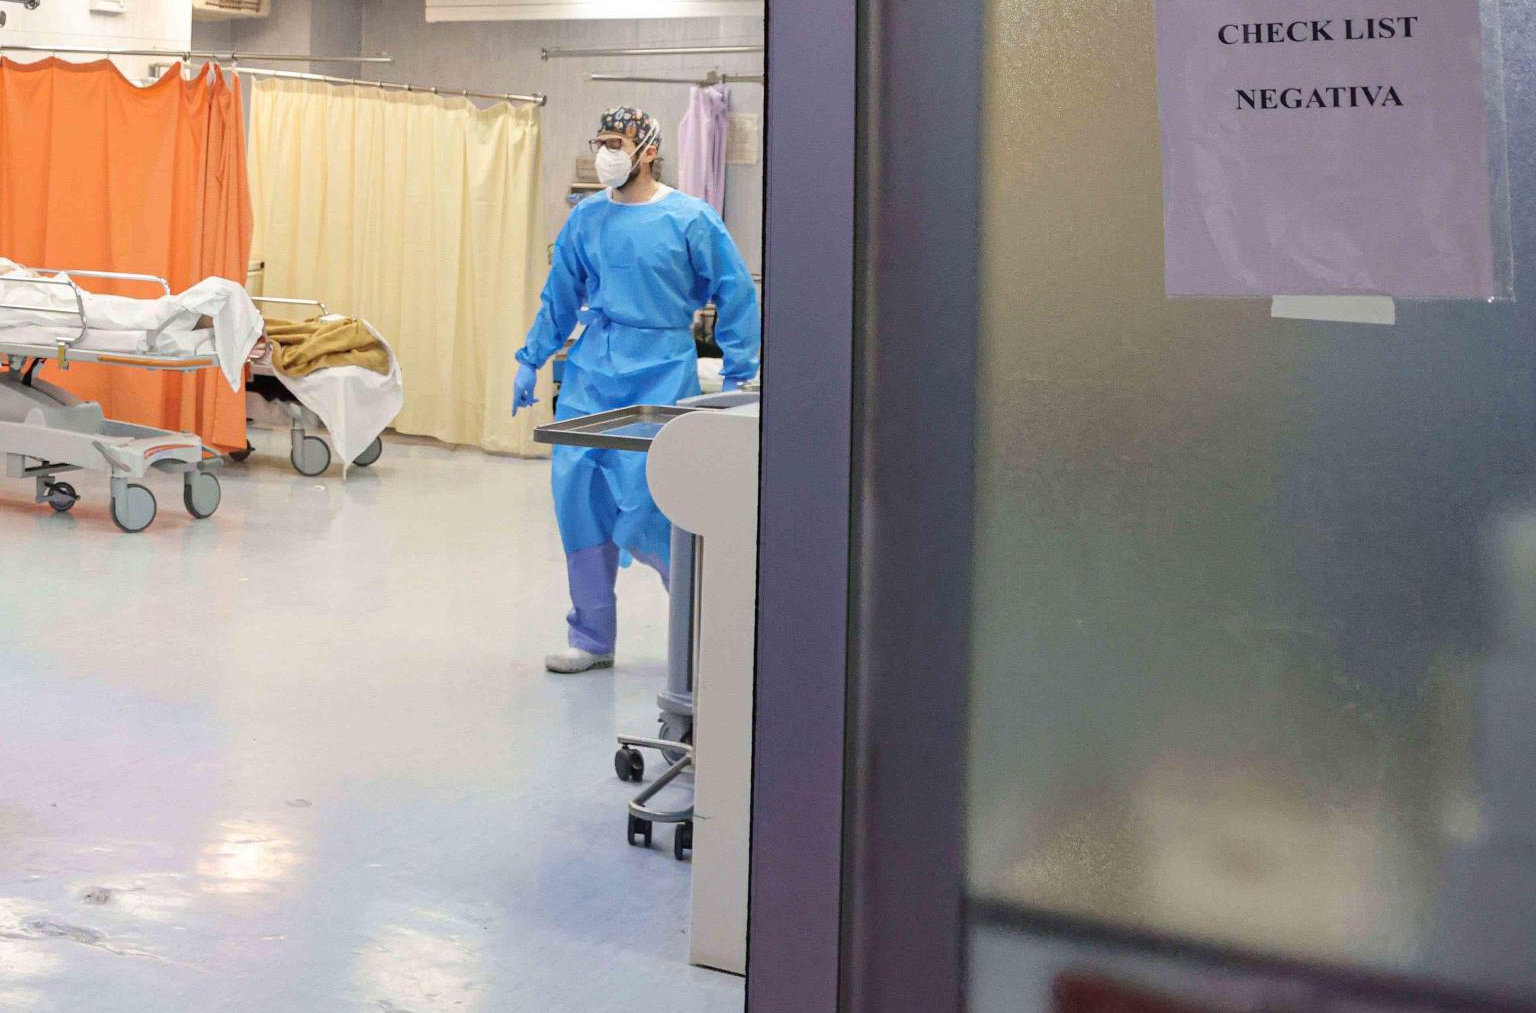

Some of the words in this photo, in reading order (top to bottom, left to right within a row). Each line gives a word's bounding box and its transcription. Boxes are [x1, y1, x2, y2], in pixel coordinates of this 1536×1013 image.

[1217, 19, 1334, 45] CHECK
[1344, 16, 1418, 40] LIST
[1234, 85, 1404, 110] NEGATIVA
